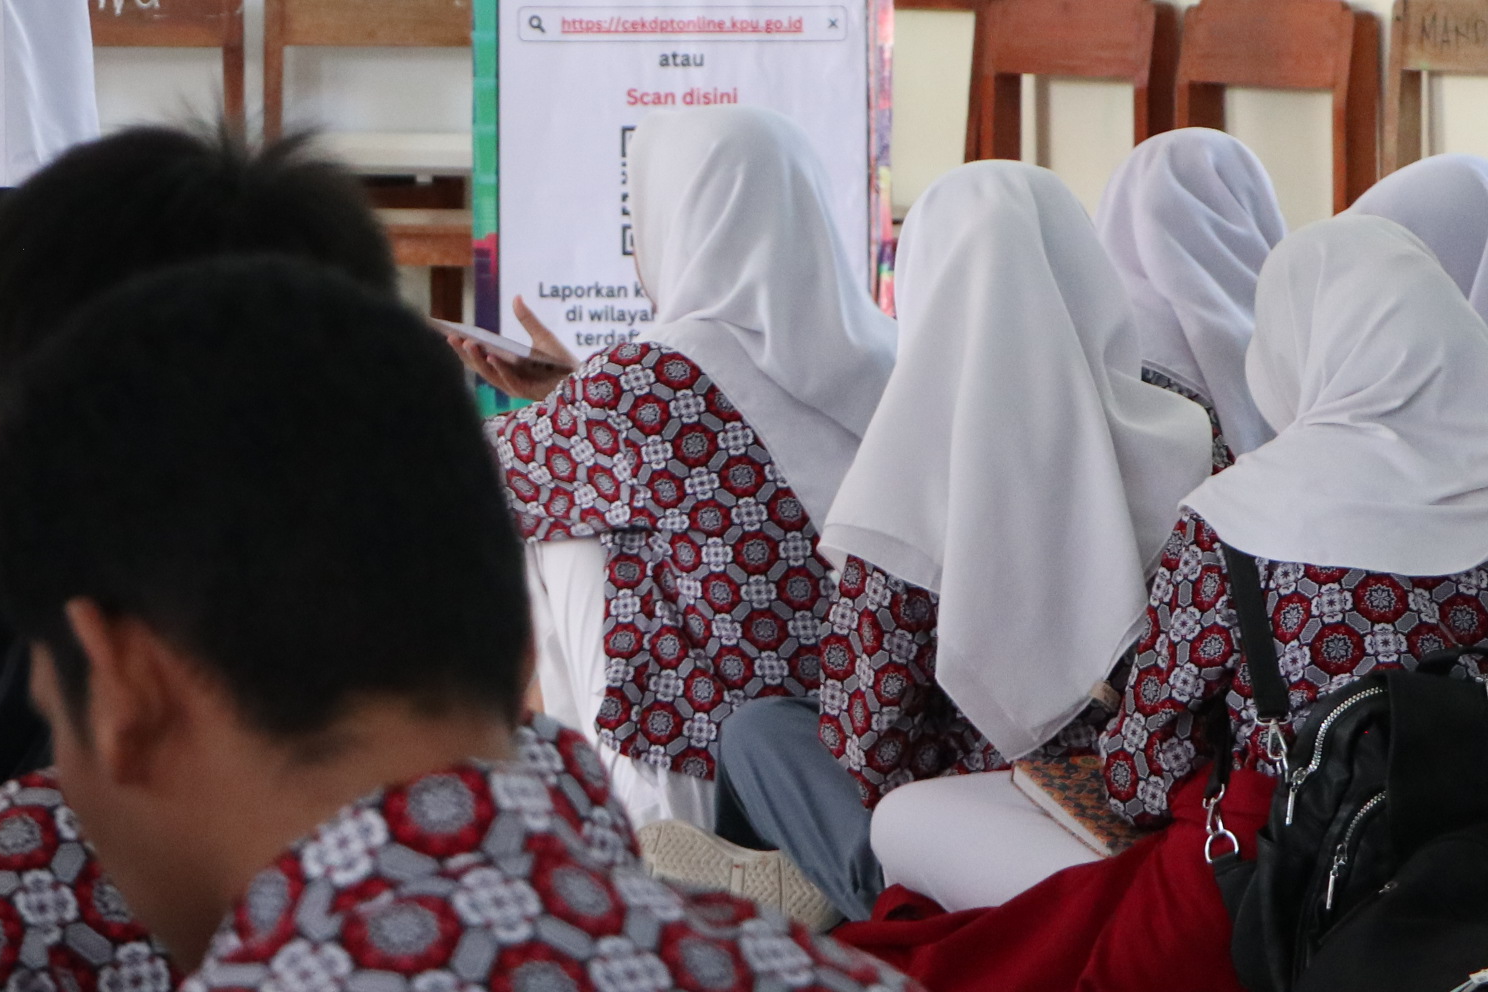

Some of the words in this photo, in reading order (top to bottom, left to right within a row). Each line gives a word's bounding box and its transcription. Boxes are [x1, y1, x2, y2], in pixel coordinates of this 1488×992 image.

[658, 51, 705, 68] atau
[626, 87, 677, 106] Scan
[682, 87, 739, 105] disini
[538, 281, 628, 302] Laporkan
[565, 305, 584, 322] di
